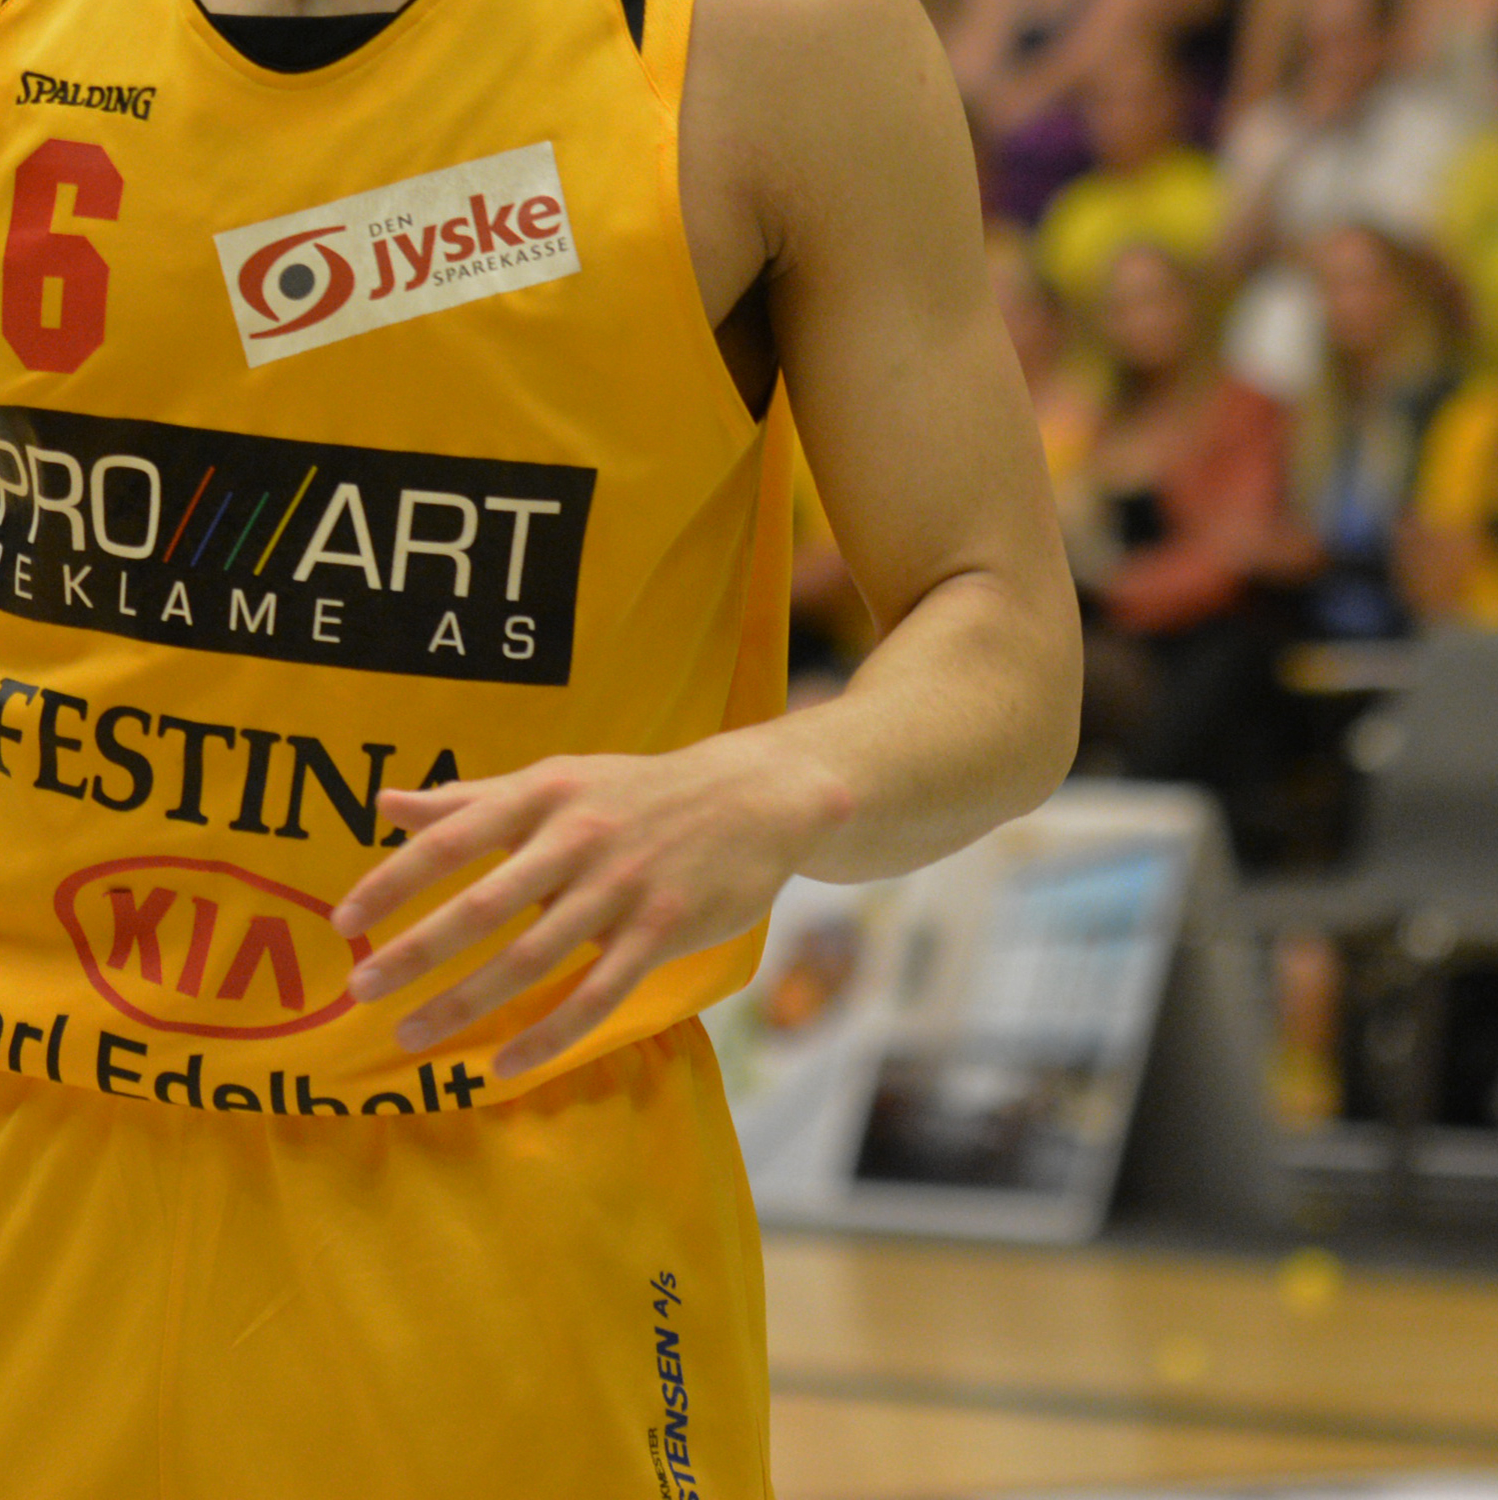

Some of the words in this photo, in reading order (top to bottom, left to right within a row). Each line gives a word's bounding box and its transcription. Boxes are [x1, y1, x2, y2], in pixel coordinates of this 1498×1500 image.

[15, 71, 156, 120] SPALDING
[368, 213, 413, 238] DEN
[1, 138, 124, 374] 6
[432, 237, 568, 286] SPAREKASSE
[428, 611, 536, 660] AS
[102, 887, 305, 1012] KIA
